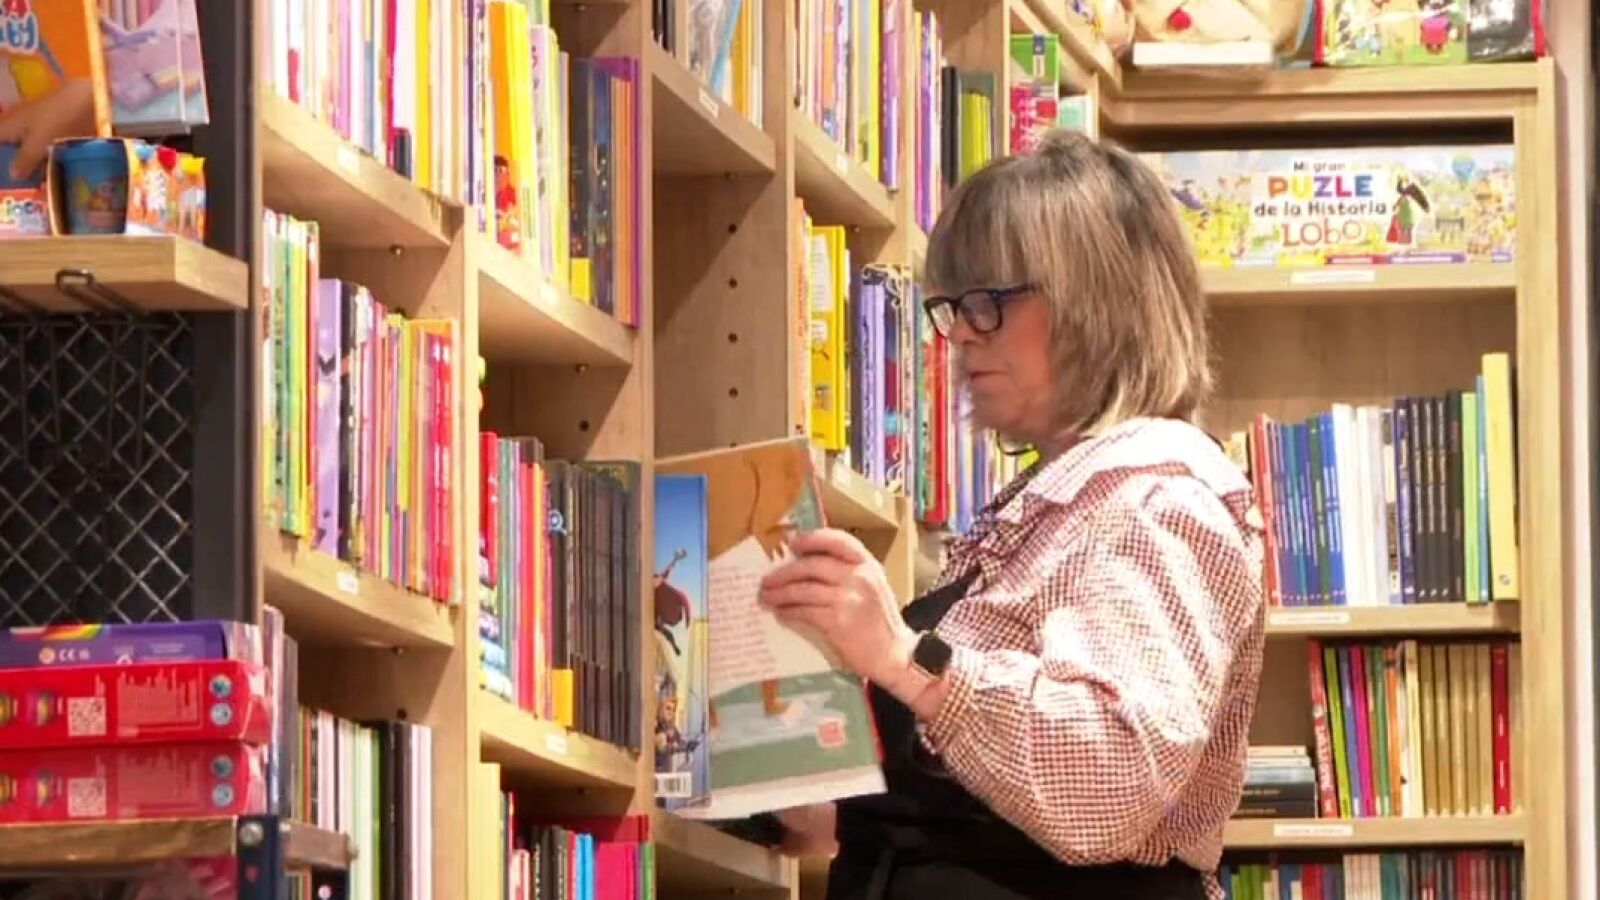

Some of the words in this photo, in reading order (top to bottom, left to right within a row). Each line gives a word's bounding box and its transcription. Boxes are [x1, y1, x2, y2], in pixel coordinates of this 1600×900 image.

[1313, 161, 1346, 173] gran
[1267, 174, 1373, 198] PUZLE
[1254, 202, 1277, 217] de
[1284, 200, 1302, 216] la
[1308, 200, 1387, 216] Historia
